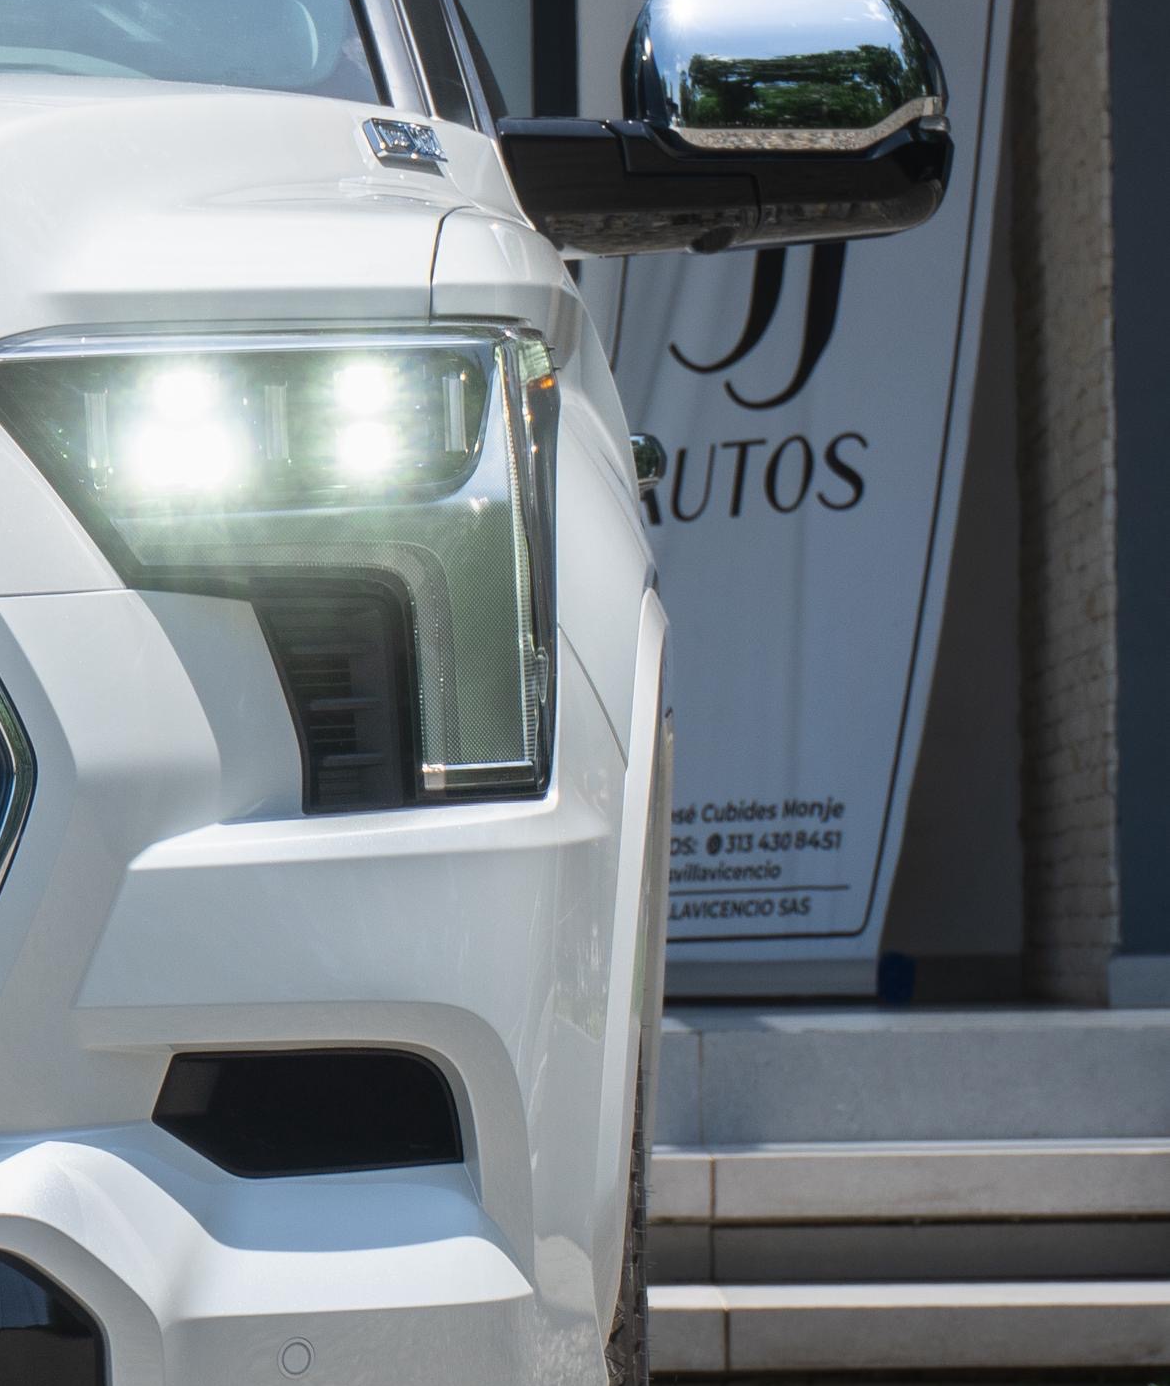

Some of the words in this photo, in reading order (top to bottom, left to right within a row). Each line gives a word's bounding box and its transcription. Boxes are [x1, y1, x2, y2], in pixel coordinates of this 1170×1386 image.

[639, 432, 869, 526] UTOS
[701, 801, 778, 824] Cubides
[782, 796, 846, 823] Monje
[778, 894, 811, 917] SAS
